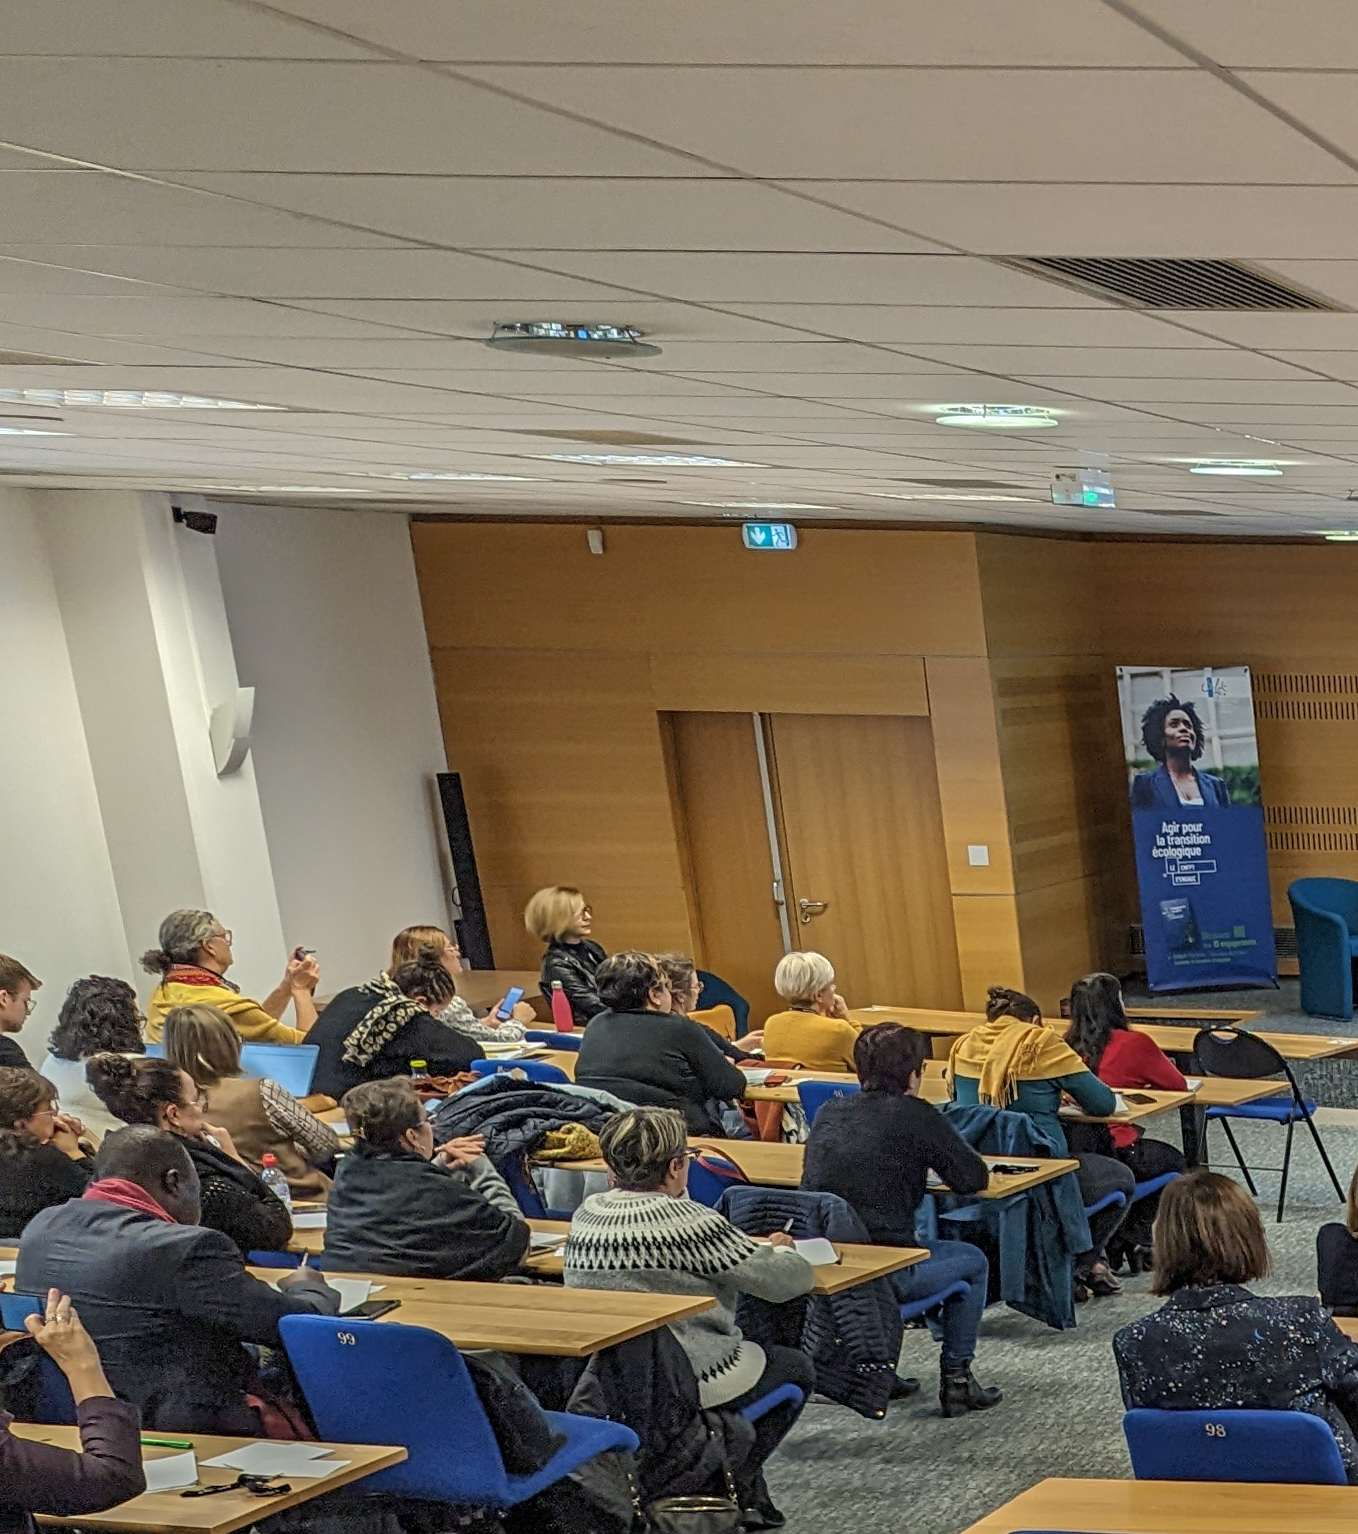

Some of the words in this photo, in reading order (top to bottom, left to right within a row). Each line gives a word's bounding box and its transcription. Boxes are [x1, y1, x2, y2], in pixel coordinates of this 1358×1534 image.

[1162, 821, 1180, 835] Agir
[1182, 823, 1203, 835] pour
[1156, 834, 1166, 846] la
[1167, 833, 1211, 846] transition
[1152, 846, 1202, 859] écologique
[337, 1332, 356, 1346] 99
[1205, 1422, 1226, 1438] 98
